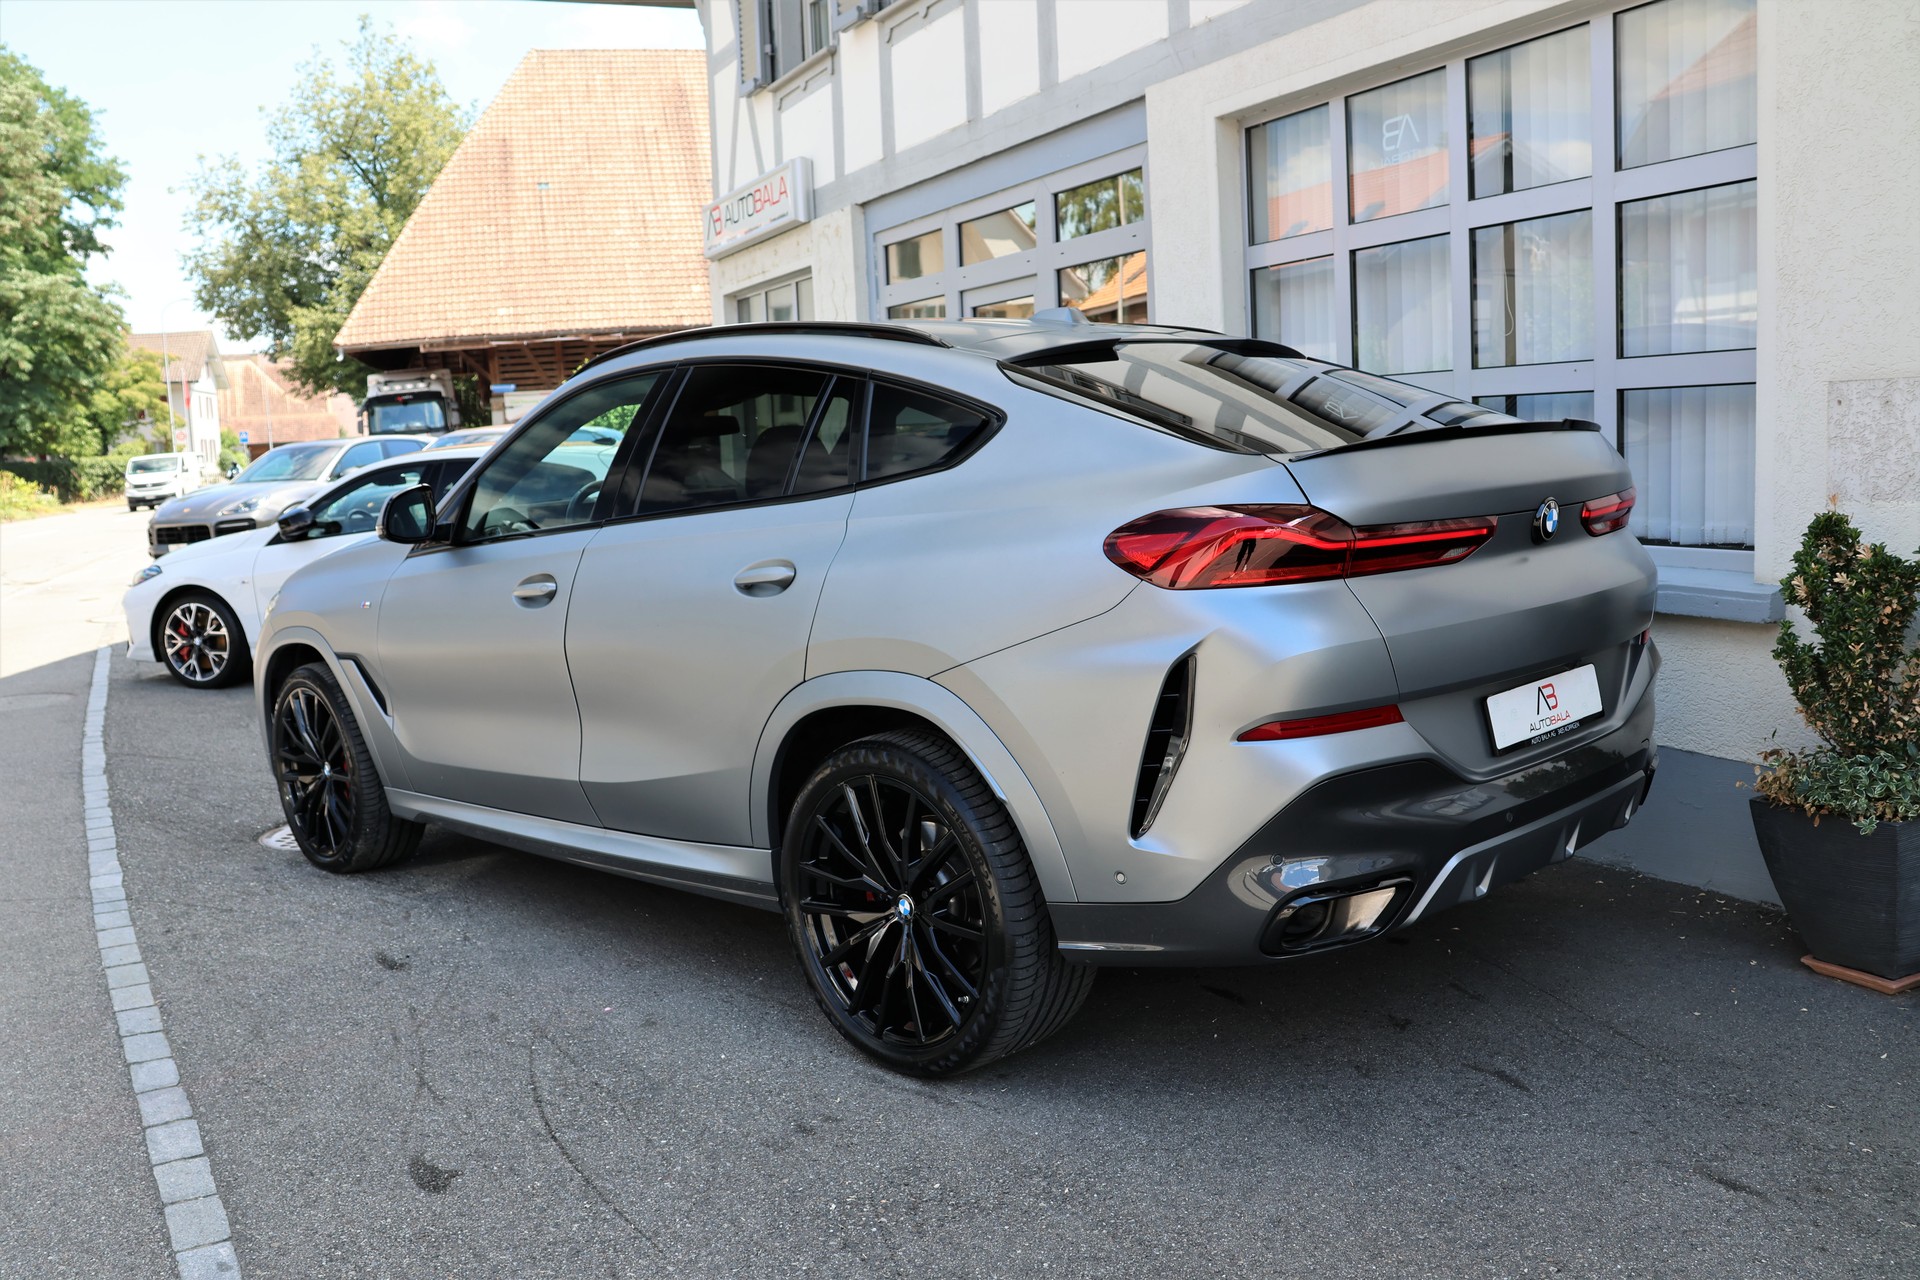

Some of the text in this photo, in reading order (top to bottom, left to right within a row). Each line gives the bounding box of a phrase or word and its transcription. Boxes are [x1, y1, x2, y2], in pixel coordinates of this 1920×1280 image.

[724, 176, 788, 228] AUTOBALA
[1530, 710, 1570, 733] AUTOBALA
[1541, 732, 1551, 741] BALA
